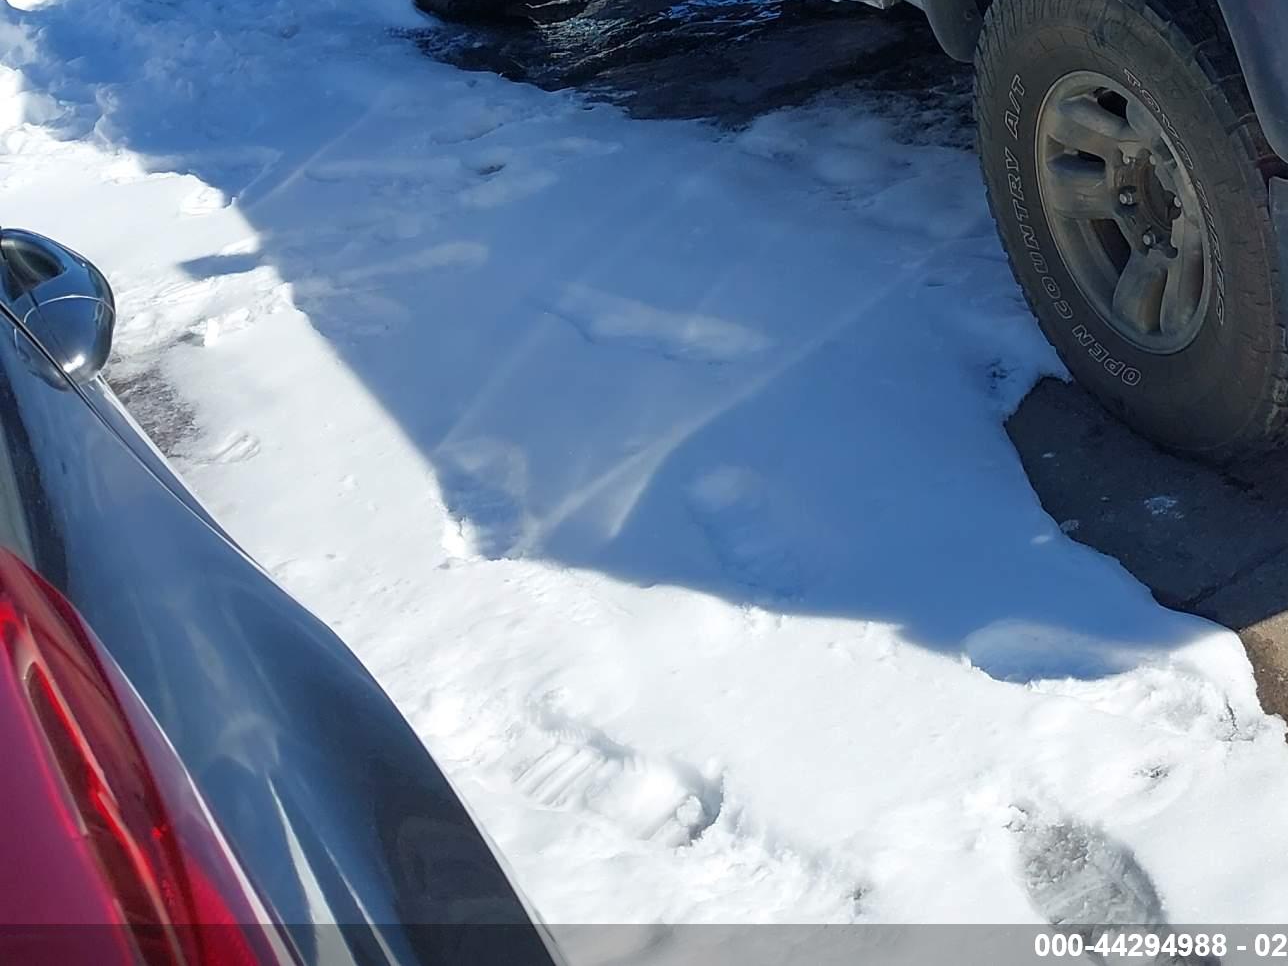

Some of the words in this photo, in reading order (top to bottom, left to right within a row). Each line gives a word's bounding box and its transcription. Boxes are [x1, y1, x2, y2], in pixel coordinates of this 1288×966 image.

[1003, 73, 1028, 140] A/T
[1000, 146, 1074, 320] COUNTRY
[1072, 324, 1142, 387] OPEN
